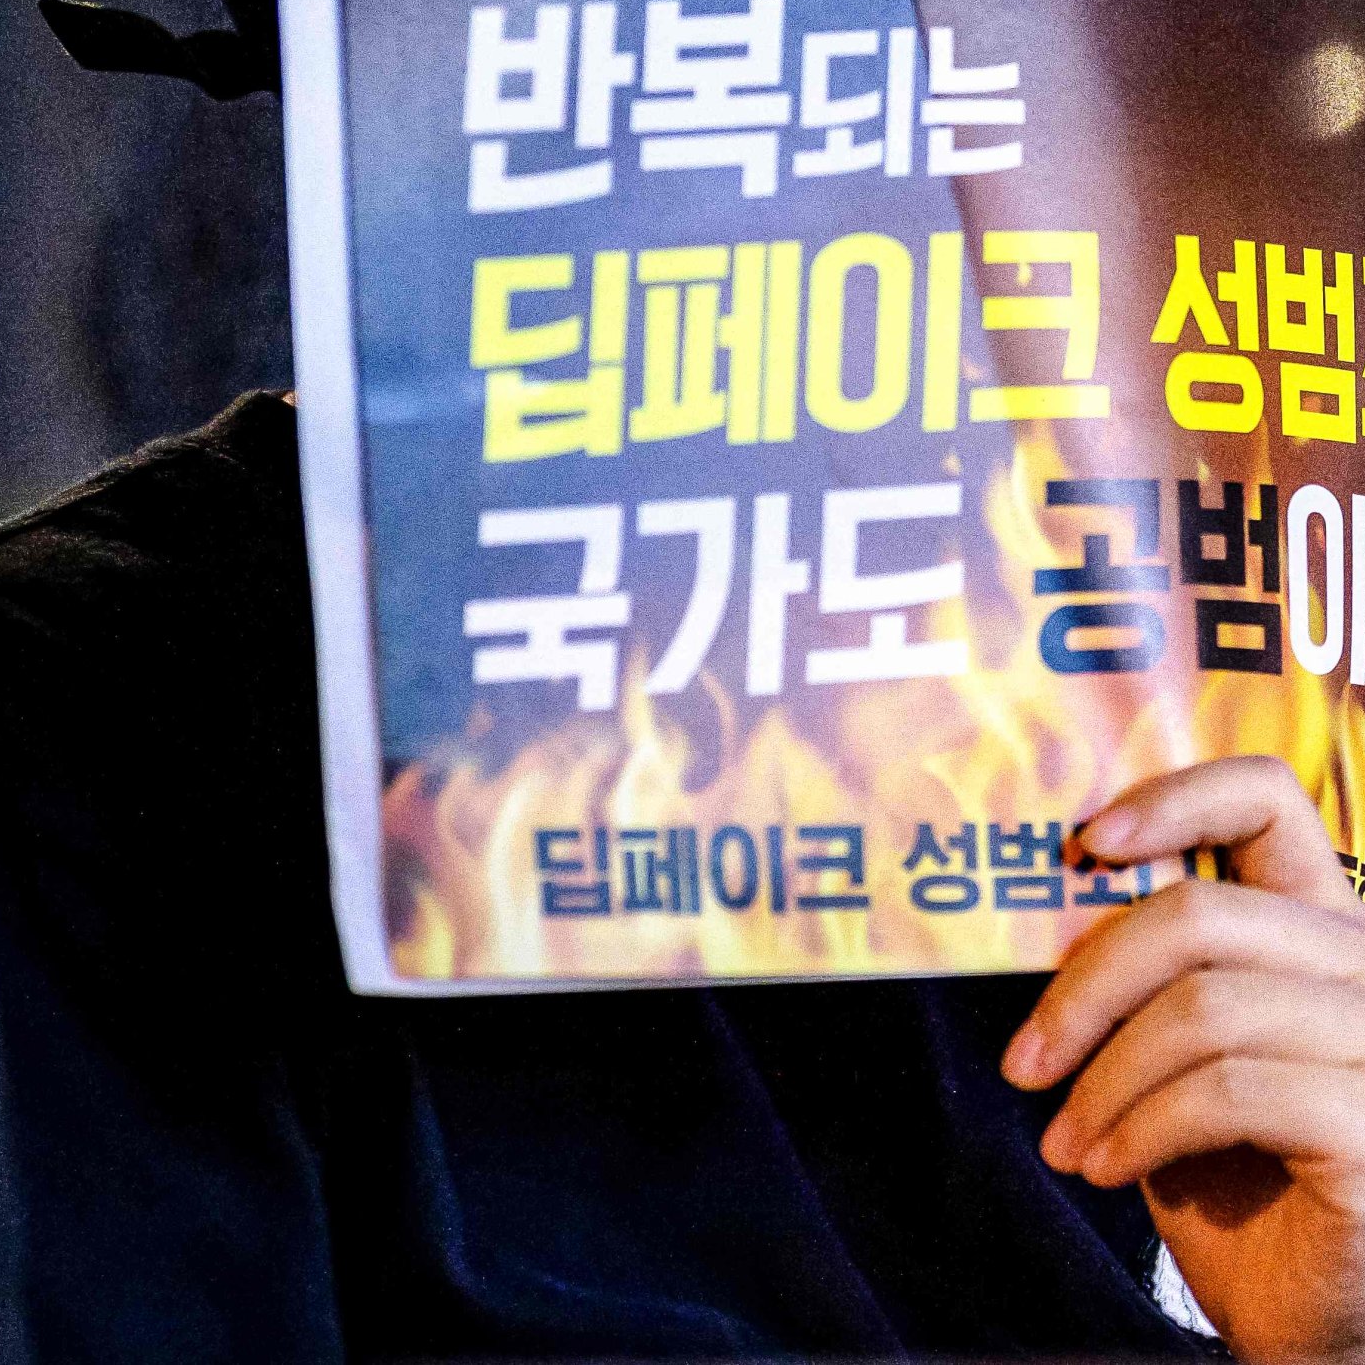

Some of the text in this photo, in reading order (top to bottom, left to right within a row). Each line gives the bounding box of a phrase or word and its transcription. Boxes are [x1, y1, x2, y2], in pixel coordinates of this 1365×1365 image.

[469, 231, 1112, 464] 딥페이크
[462, 481, 969, 711] 국가도
[532, 822, 870, 918] 딥페이크
